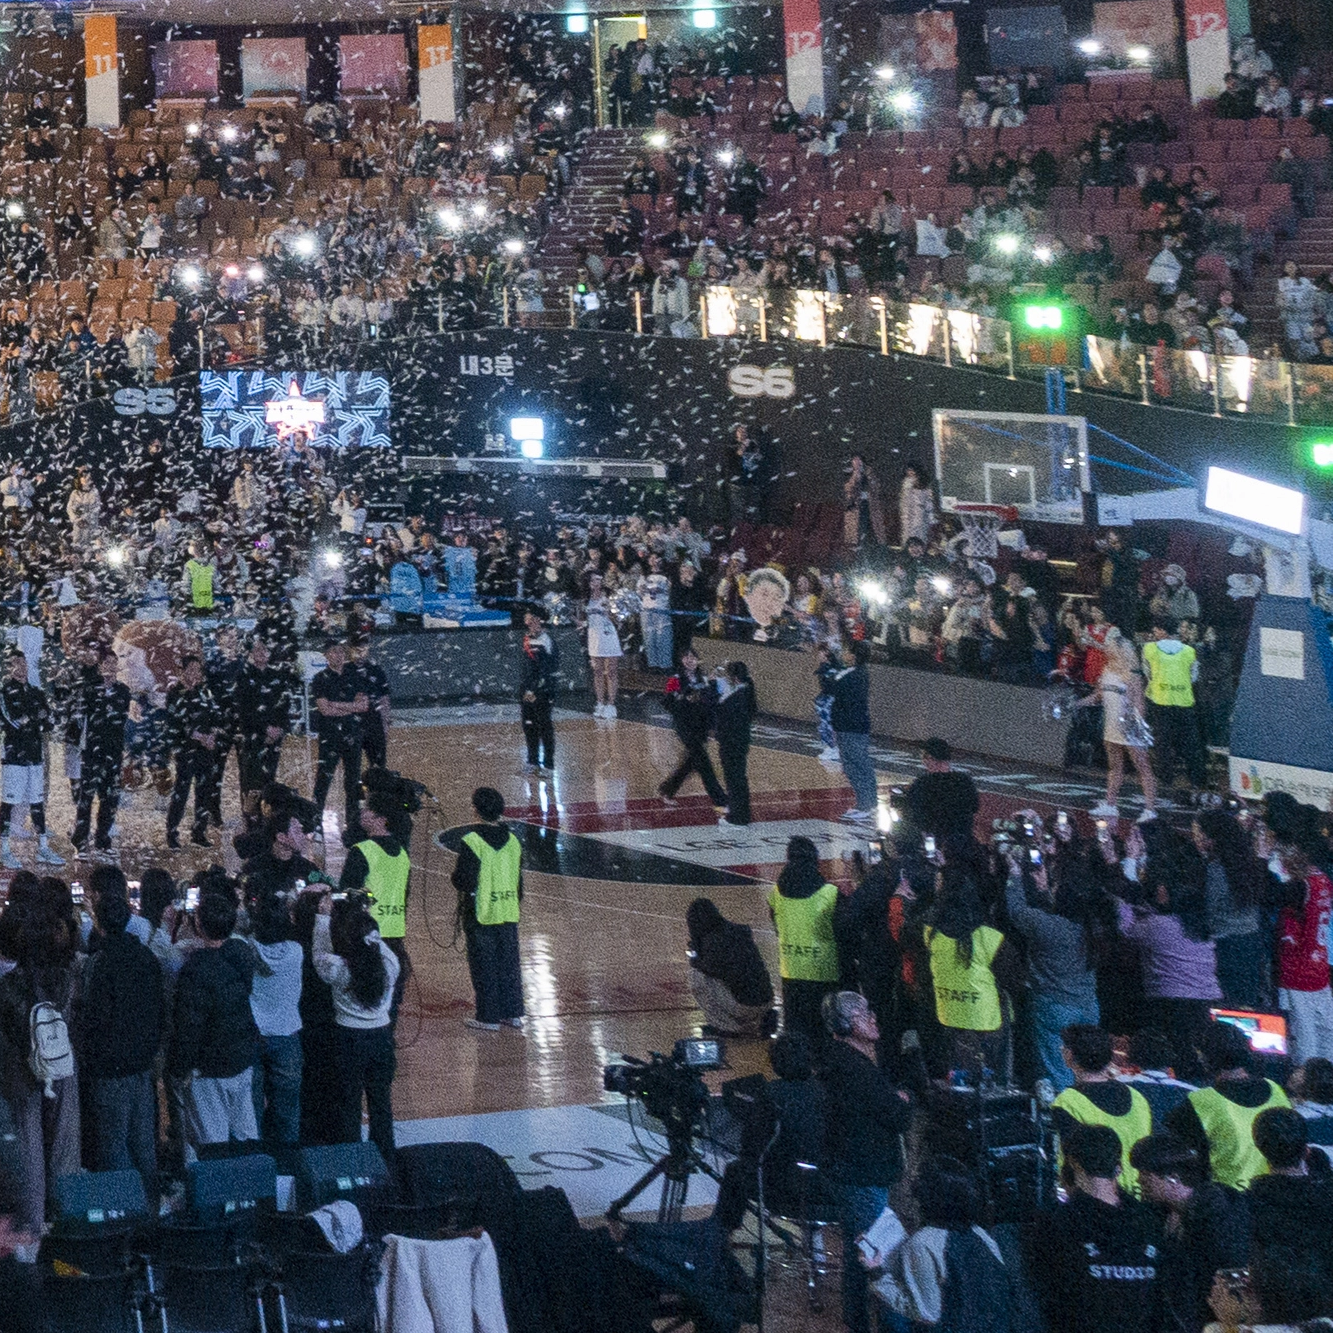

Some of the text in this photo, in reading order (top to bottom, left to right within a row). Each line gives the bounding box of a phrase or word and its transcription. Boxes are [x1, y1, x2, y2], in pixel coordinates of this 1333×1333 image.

[1189, 12, 1221, 36] 12
[787, 30, 816, 54] 12
[92, 54, 112, 75] 11
[459, 354, 515, 377] 내3문
[729, 365, 795, 397] S6
[113, 387, 177, 416] S5
[377, 904, 405, 916] STAF
[782, 944, 821, 958] STAFF
[937, 987, 981, 1004] STAFF
